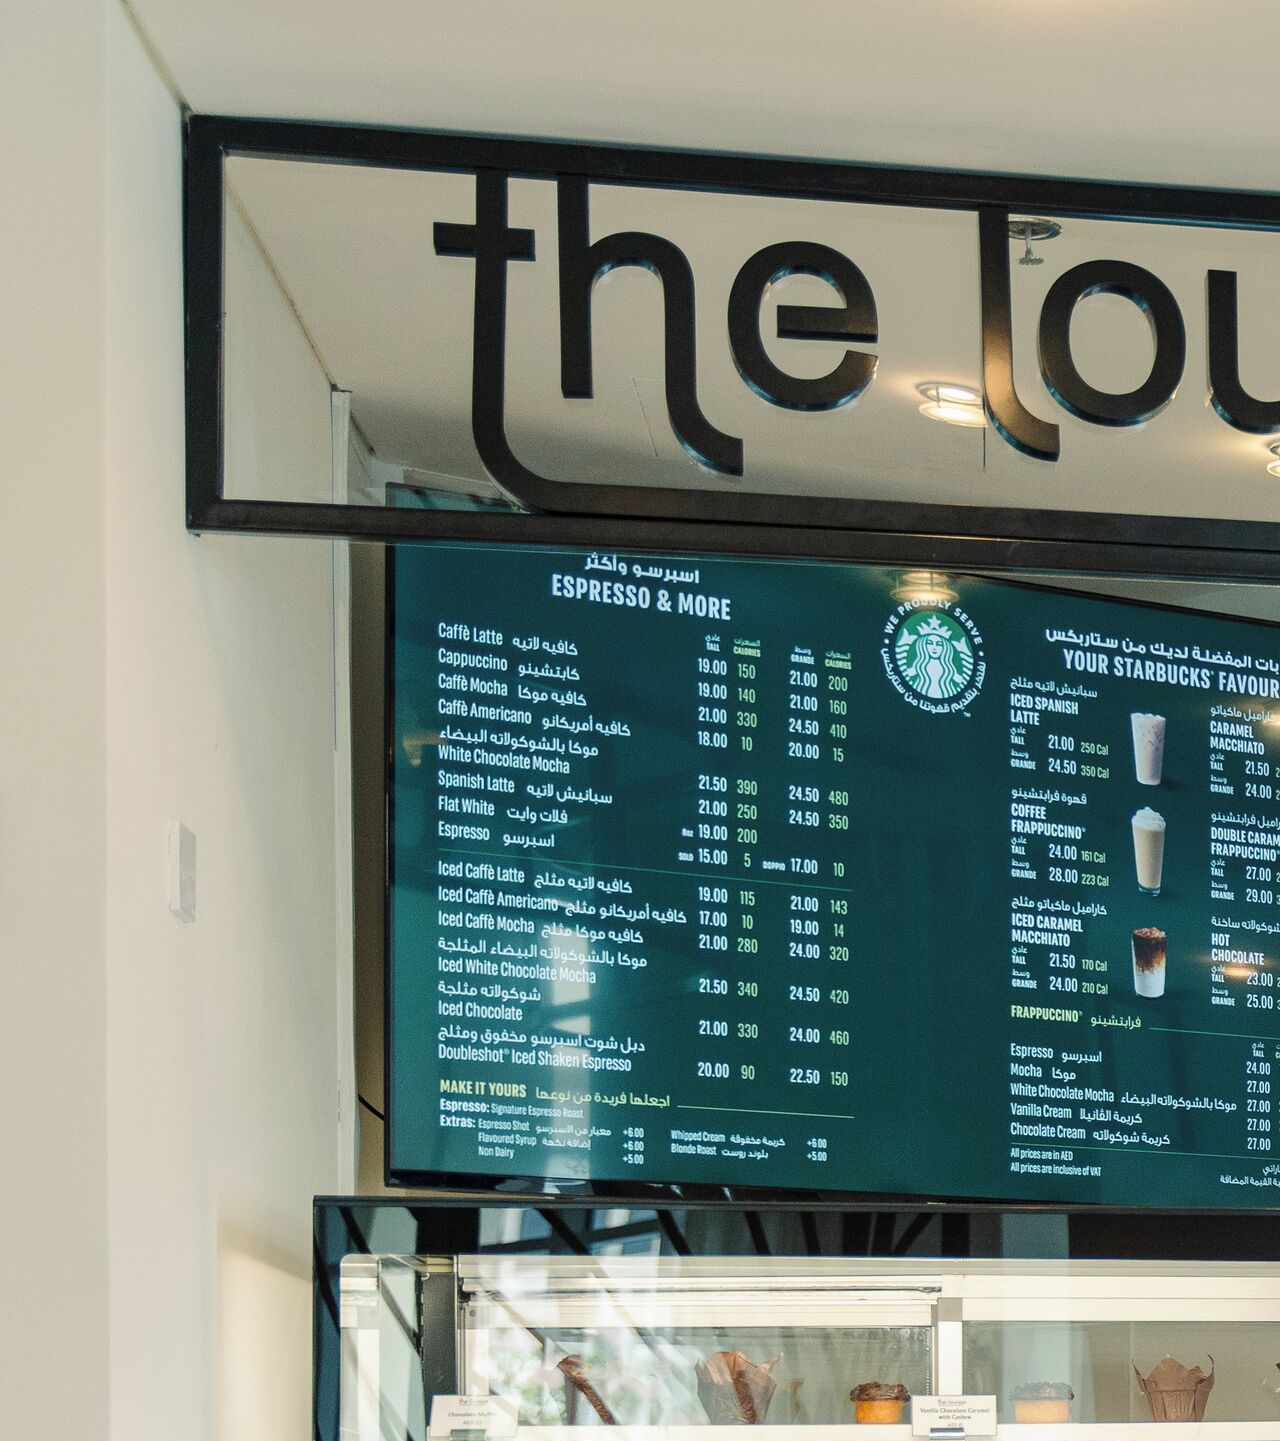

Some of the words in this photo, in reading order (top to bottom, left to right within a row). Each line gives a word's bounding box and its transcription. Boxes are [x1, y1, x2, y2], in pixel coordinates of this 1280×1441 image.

[430, 165, 880, 520] the
[552, 574, 651, 609] ESPRESSO
[657, 592, 672, 612] &
[678, 593, 730, 620] MORE
[439, 623, 470, 640] Caffè
[474, 627, 502, 645] Latte
[698, 658, 727, 675] 19.00
[790, 670, 817, 687] 21.00
[1063, 649, 1108, 674] YOUR
[439, 648, 507, 671] Cappuccino
[698, 682, 727, 699] 19.00
[790, 694, 817, 711] 21.00
[438, 673, 468, 691] Caffè
[470, 677, 507, 696] Mocha
[698, 707, 727, 723] 21.00
[789, 718, 819, 735] 24.50
[1011, 693, 1033, 708] ICED
[1034, 698, 1078, 716] SPANISH
[1011, 709, 1039, 725] LATTE
[438, 699, 468, 716] Caffè
[470, 703, 531, 724] Americano
[698, 731, 727, 748] 18.00
[789, 742, 819, 759] 20.00
[1210, 722, 1254, 739] CARAMEL
[1048, 735, 1074, 751] 21.00
[1210, 736, 1264, 757] MACCHIATO
[439, 745, 471, 762] White
[474, 749, 530, 769] Chocolate
[533, 756, 569, 773] Mocha
[699, 775, 727, 791] 21.50
[789, 785, 819, 802] 24.50
[1048, 758, 1076, 774] 24.50
[1246, 761, 1269, 776] 21.50
[438, 770, 484, 789] Spanish
[487, 776, 514, 793] Latte
[699, 799, 727, 816] 21.00
[789, 810, 819, 826] 24.50
[1246, 783, 1271, 799] 24.00
[439, 796, 459, 812] Flat
[462, 799, 494, 816] White
[699, 824, 727, 840] 19.00
[1011, 803, 1046, 819] COFFEE
[1211, 827, 1246, 843] DOUBLE
[439, 821, 489, 840] Espresso
[699, 849, 727, 865] 15.00
[791, 858, 818, 874] 17.00
[1049, 844, 1077, 860] 24.00
[1049, 867, 1078, 883] 28.00
[1246, 866, 1271, 881] 27.00
[439, 861, 463, 877] Iced
[465, 863, 494, 880] Caffè
[497, 867, 524, 883] Latte
[699, 887, 727, 903] 19.00
[791, 896, 818, 912] 21.00
[1246, 889, 1272, 904] 29.00
[439, 886, 462, 902] Iced
[465, 889, 494, 905] Caffè
[497, 888, 558, 912] Americano
[699, 911, 727, 927] 17.00
[790, 919, 819, 935] 19.00
[1012, 913, 1034, 927] ICED
[1037, 916, 1083, 932] CARAMEL
[438, 911, 462, 927] Iced
[465, 913, 494, 929] Caffè
[497, 916, 534, 933] Mocha
[699, 934, 727, 950] 21.00
[790, 942, 820, 958] 24.00
[1012, 929, 1070, 947] MACCHIATO
[1212, 933, 1230, 946] HOT
[1050, 953, 1075, 968] 21.50
[1212, 948, 1264, 965] CHOCOLATE
[439, 957, 462, 972] Iced
[465, 959, 498, 975] White
[501, 962, 556, 979] Chocolate
[560, 968, 596, 983] Mocha
[699, 978, 727, 994] 21.50
[790, 986, 820, 1002] 24.50
[1050, 976, 1077, 992] 24.00
[1247, 971, 1273, 987] 23.00
[1247, 994, 1273, 1009] 25.00
[439, 1000, 463, 1016] Iced
[465, 1002, 522, 1020] Chocolate
[699, 1020, 727, 1036] 21.00
[790, 1027, 820, 1043] 24.00
[511, 1049, 535, 1065] Iced
[537, 1052, 580, 1067] Shaken
[582, 1053, 631, 1072] Espresso
[698, 1062, 729, 1078] 20.00
[790, 1068, 820, 1084] 22.50
[1011, 1043, 1053, 1058] Espresso
[1247, 1062, 1270, 1075] 24.00
[440, 1079, 472, 1094] MAKE
[475, 1081, 485, 1096] IT
[488, 1082, 526, 1098] YOURS
[1011, 1063, 1042, 1077] Mocha
[1247, 1080, 1270, 1093] 27.00
[1010, 1083, 1037, 1096] White
[1039, 1085, 1083, 1100] Chocolate
[1085, 1088, 1114, 1102] Mocha
[1247, 1100, 1270, 1112] 27.00
[1010, 1103, 1041, 1116] Vanilla
[1043, 1105, 1071, 1118] Cream
[1247, 1118, 1270, 1131] 27.00
[1011, 1122, 1055, 1137] Chocolate
[1057, 1125, 1085, 1139] Cream
[1248, 1137, 1270, 1150] 27.00
